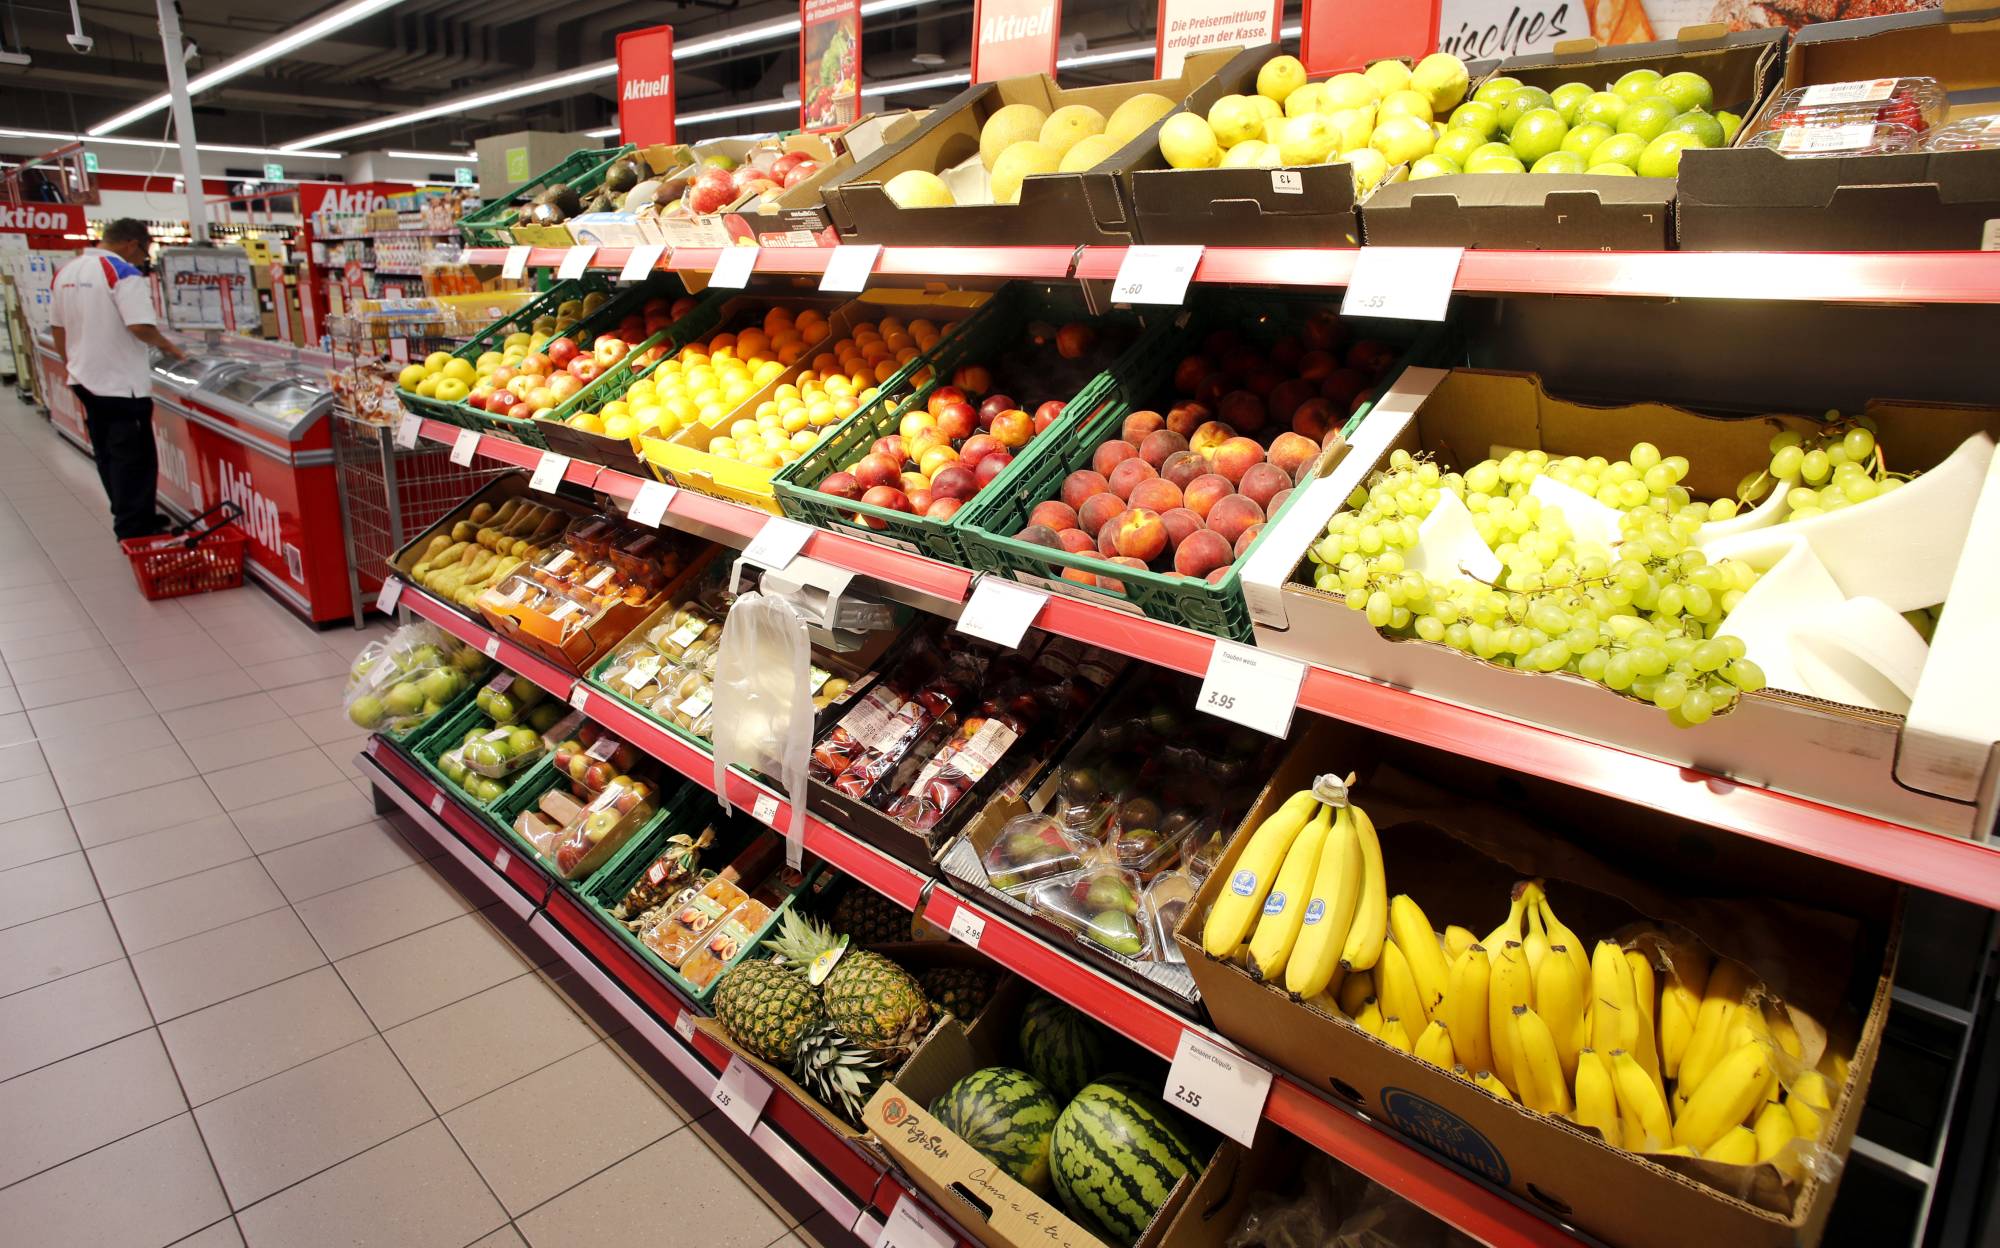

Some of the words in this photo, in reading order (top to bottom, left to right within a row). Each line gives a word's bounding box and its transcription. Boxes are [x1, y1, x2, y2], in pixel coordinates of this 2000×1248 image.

[980, 6, 1053, 45] Aktuell
[1171, 20, 1187, 33] Die
[1188, 9, 1267, 30] Preisermittlung
[1167, 34, 1201, 49] erfolgt
[1201, 34, 1215, 44] an
[1216, 30, 1234, 43] der
[1235, 26, 1268, 41] Kasse.
[623, 74, 670, 101] Aktuell
[319, 188, 388, 216] Aktio
[0, 205, 69, 231] ktion
[174, 272, 247, 287] DENNER
[1121, 283, 1143, 295] -.60
[1358, 295, 1386, 308] -.55
[219, 457, 282, 557] Aktion
[1207, 691, 1236, 710] 3.95
[965, 925, 981, 940] 2.95
[1189, 1044, 1211, 1060] Bananen
[1211, 1055, 1232, 1071] Chiquita
[716, 1090, 731, 1106] 2.35
[1175, 1084, 1202, 1108] 2.55
[897, 1114, 950, 1159] PozoSur
